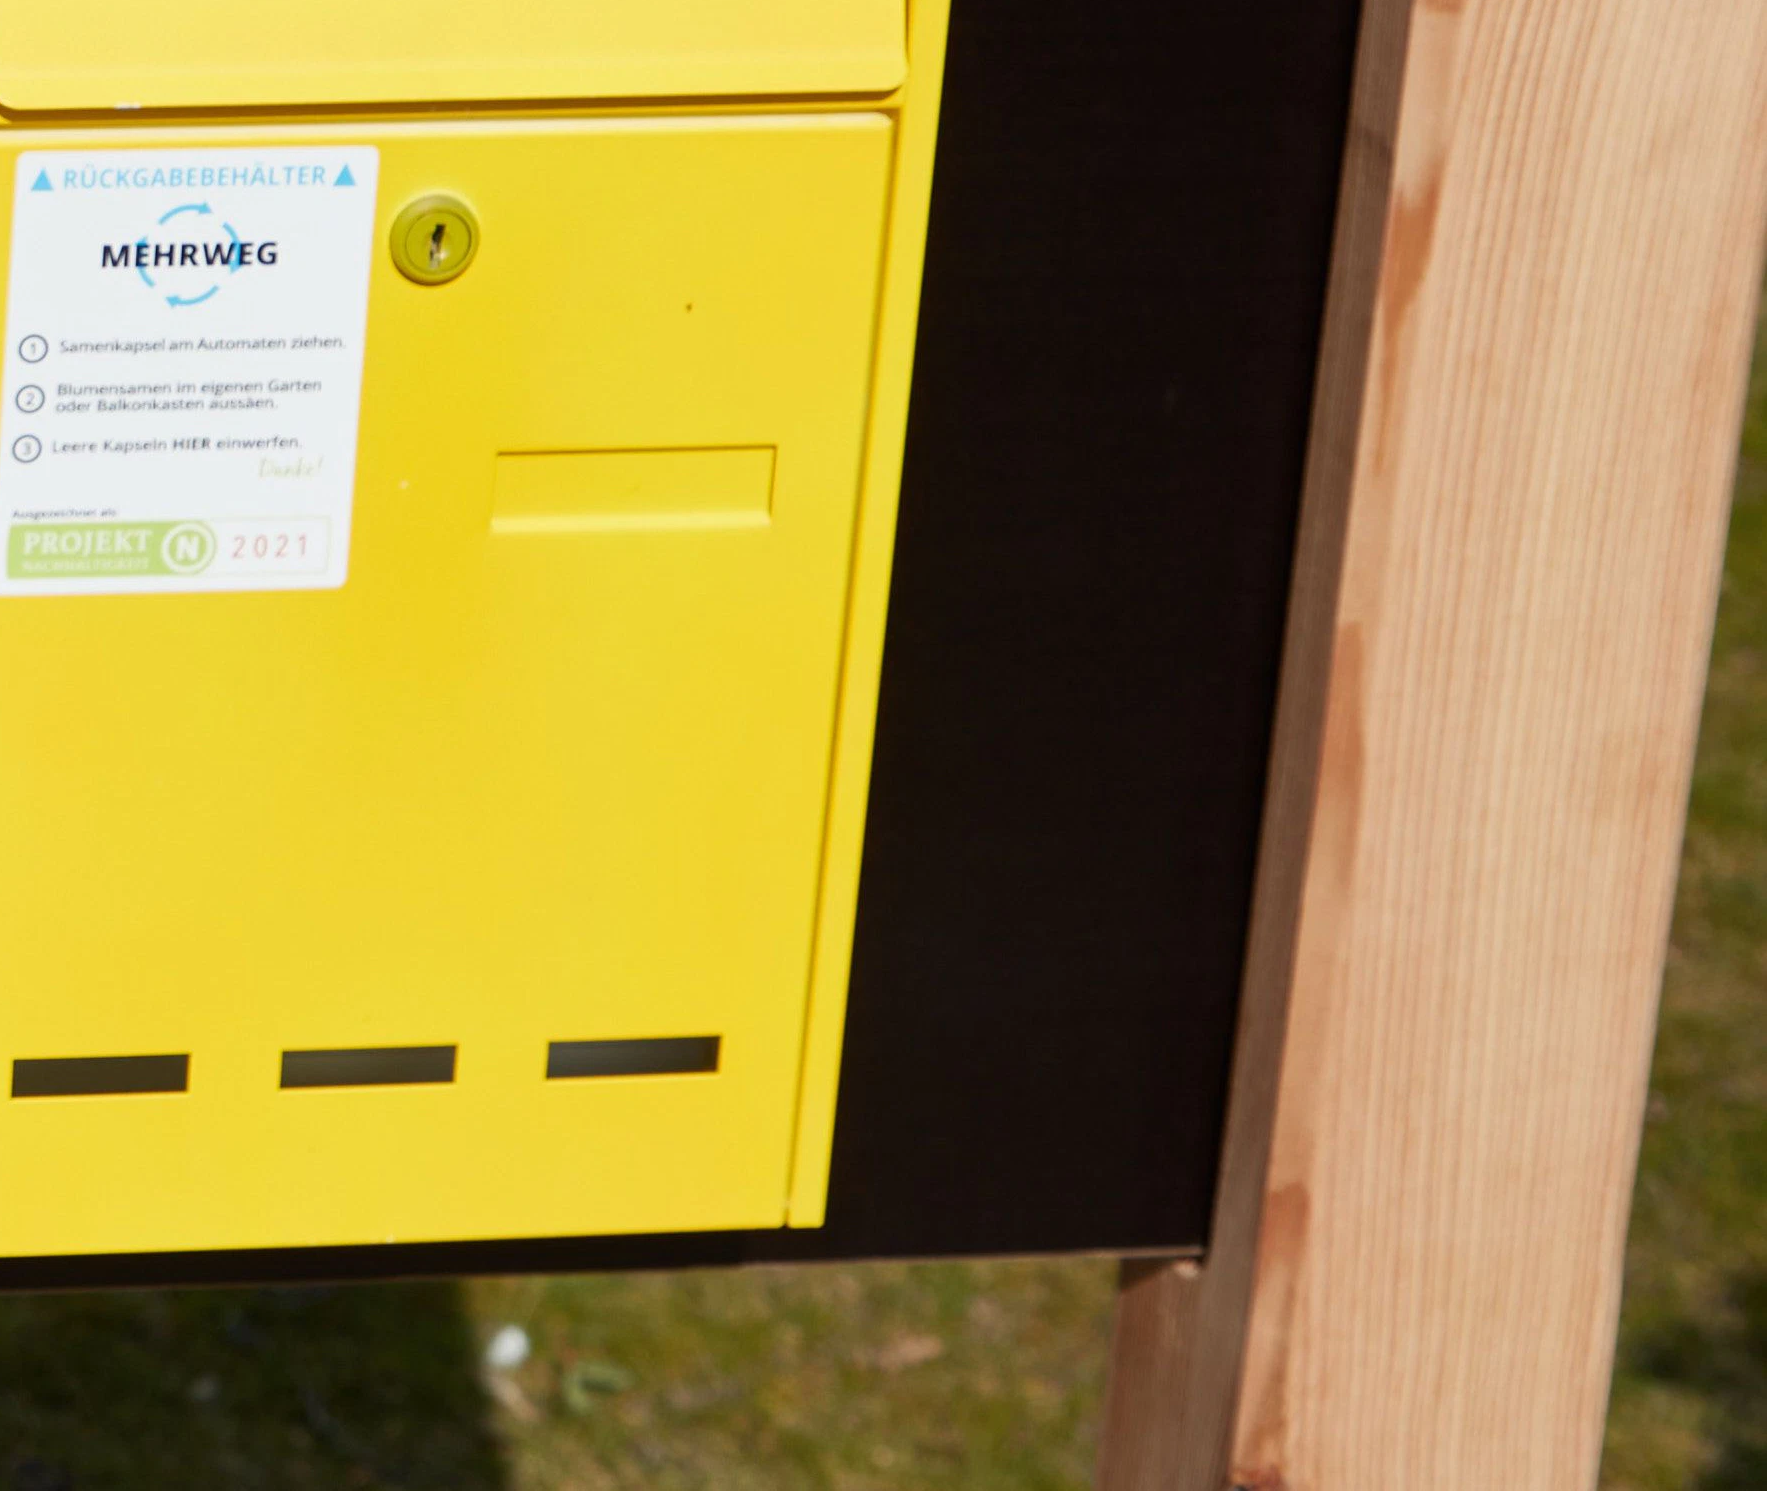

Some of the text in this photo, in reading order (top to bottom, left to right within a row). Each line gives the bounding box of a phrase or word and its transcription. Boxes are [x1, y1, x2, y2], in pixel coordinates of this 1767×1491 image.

[63, 165, 326, 190] RÜCKGABEBEHÄLTER
[102, 242, 278, 268] MEHRWEG
[60, 338, 166, 355] Samenkapsel
[168, 340, 194, 352] am
[196, 337, 287, 351] Automaten
[290, 336, 346, 350] ziehen.
[57, 383, 172, 397] Blumensamen
[176, 383, 197, 394] im
[200, 382, 263, 397] eigenen
[267, 379, 322, 393] Garten
[55, 400, 91, 413] oder
[97, 398, 205, 412] Balkonkasten
[52, 442, 98, 453] Leere
[102, 439, 168, 455] Kapseln
[172, 437, 211, 451] HIER
[216, 435, 303, 449] einwerfen.
[22, 527, 152, 556] PROJEKT
[231, 535, 308, 559] 2021
